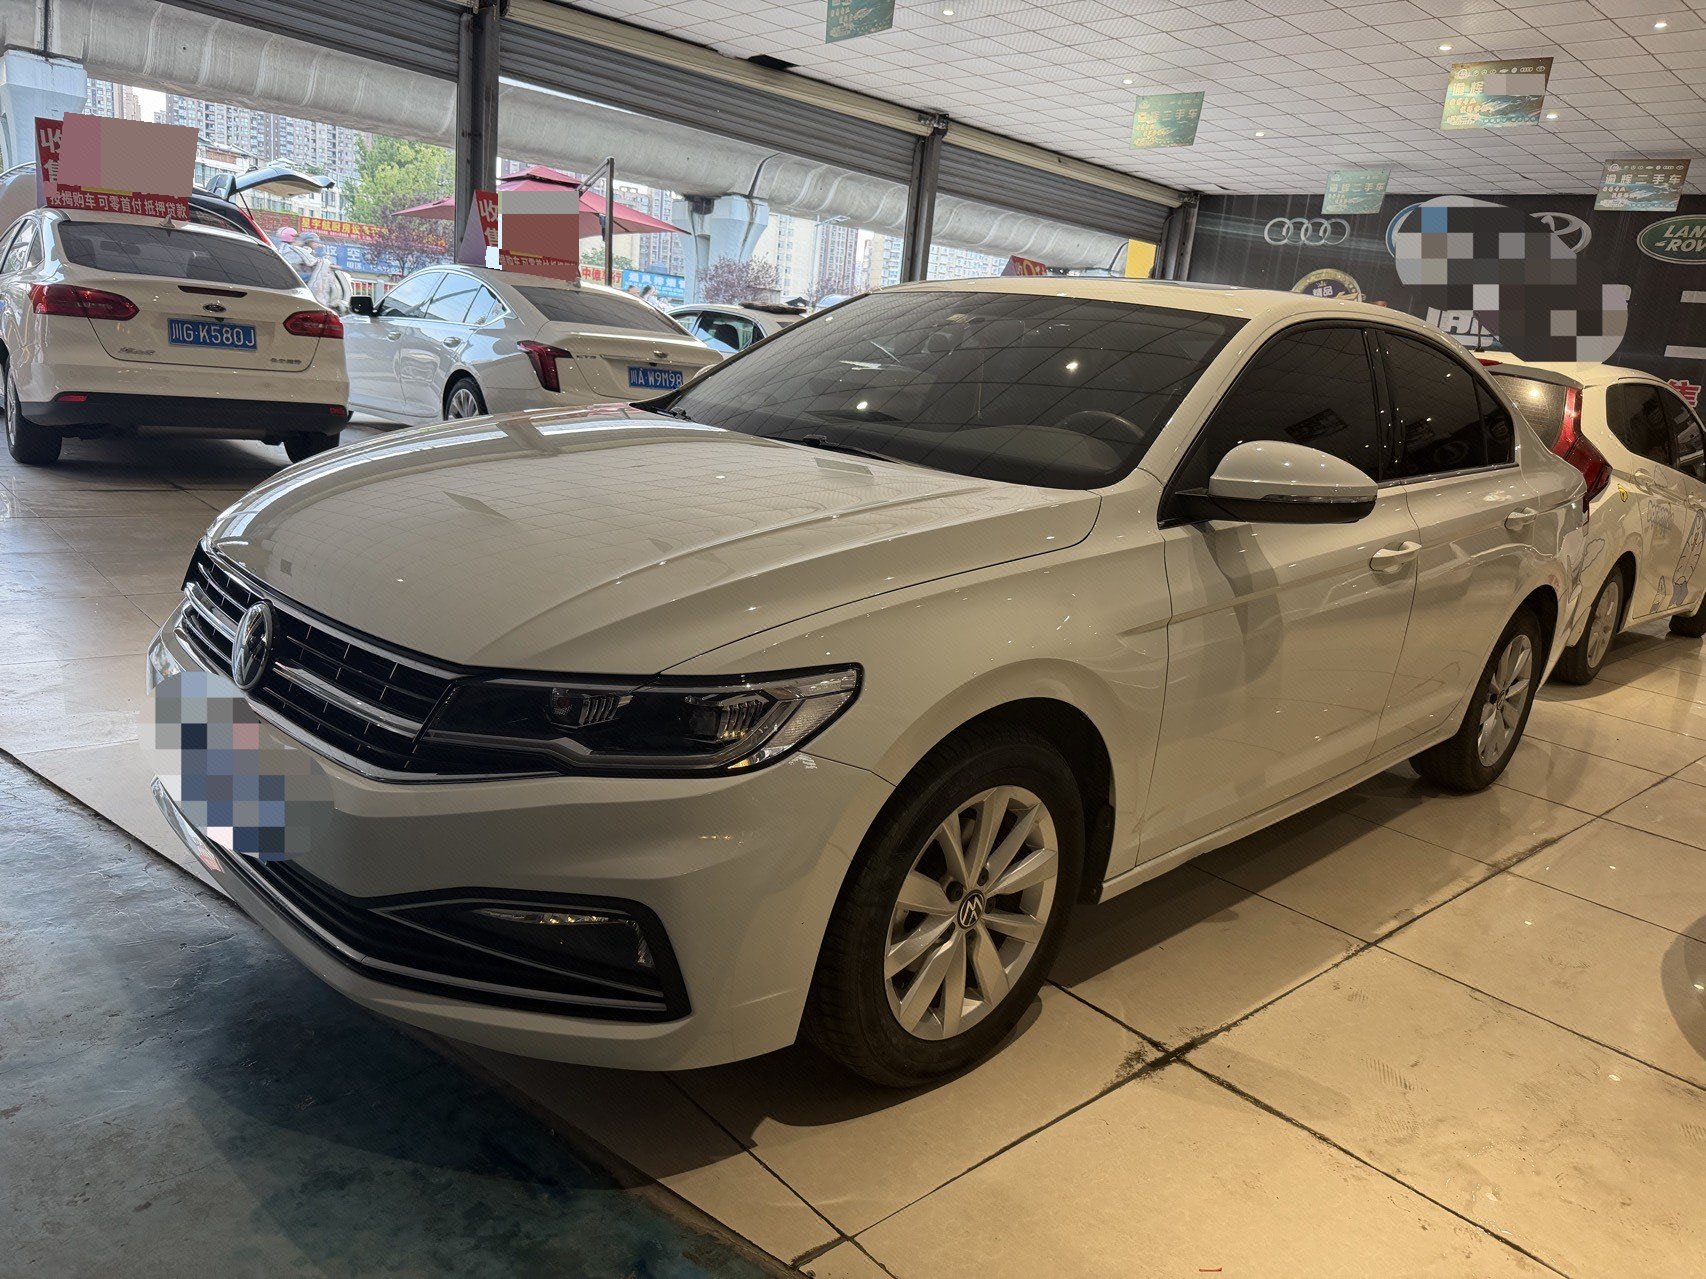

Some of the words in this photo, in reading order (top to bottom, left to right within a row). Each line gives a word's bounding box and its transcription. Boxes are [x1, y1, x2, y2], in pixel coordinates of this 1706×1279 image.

[97, 194, 142, 214] 可零首付
[1663, 225, 1706, 238] LAN
[171, 322, 255, 347] 川G·K580J
